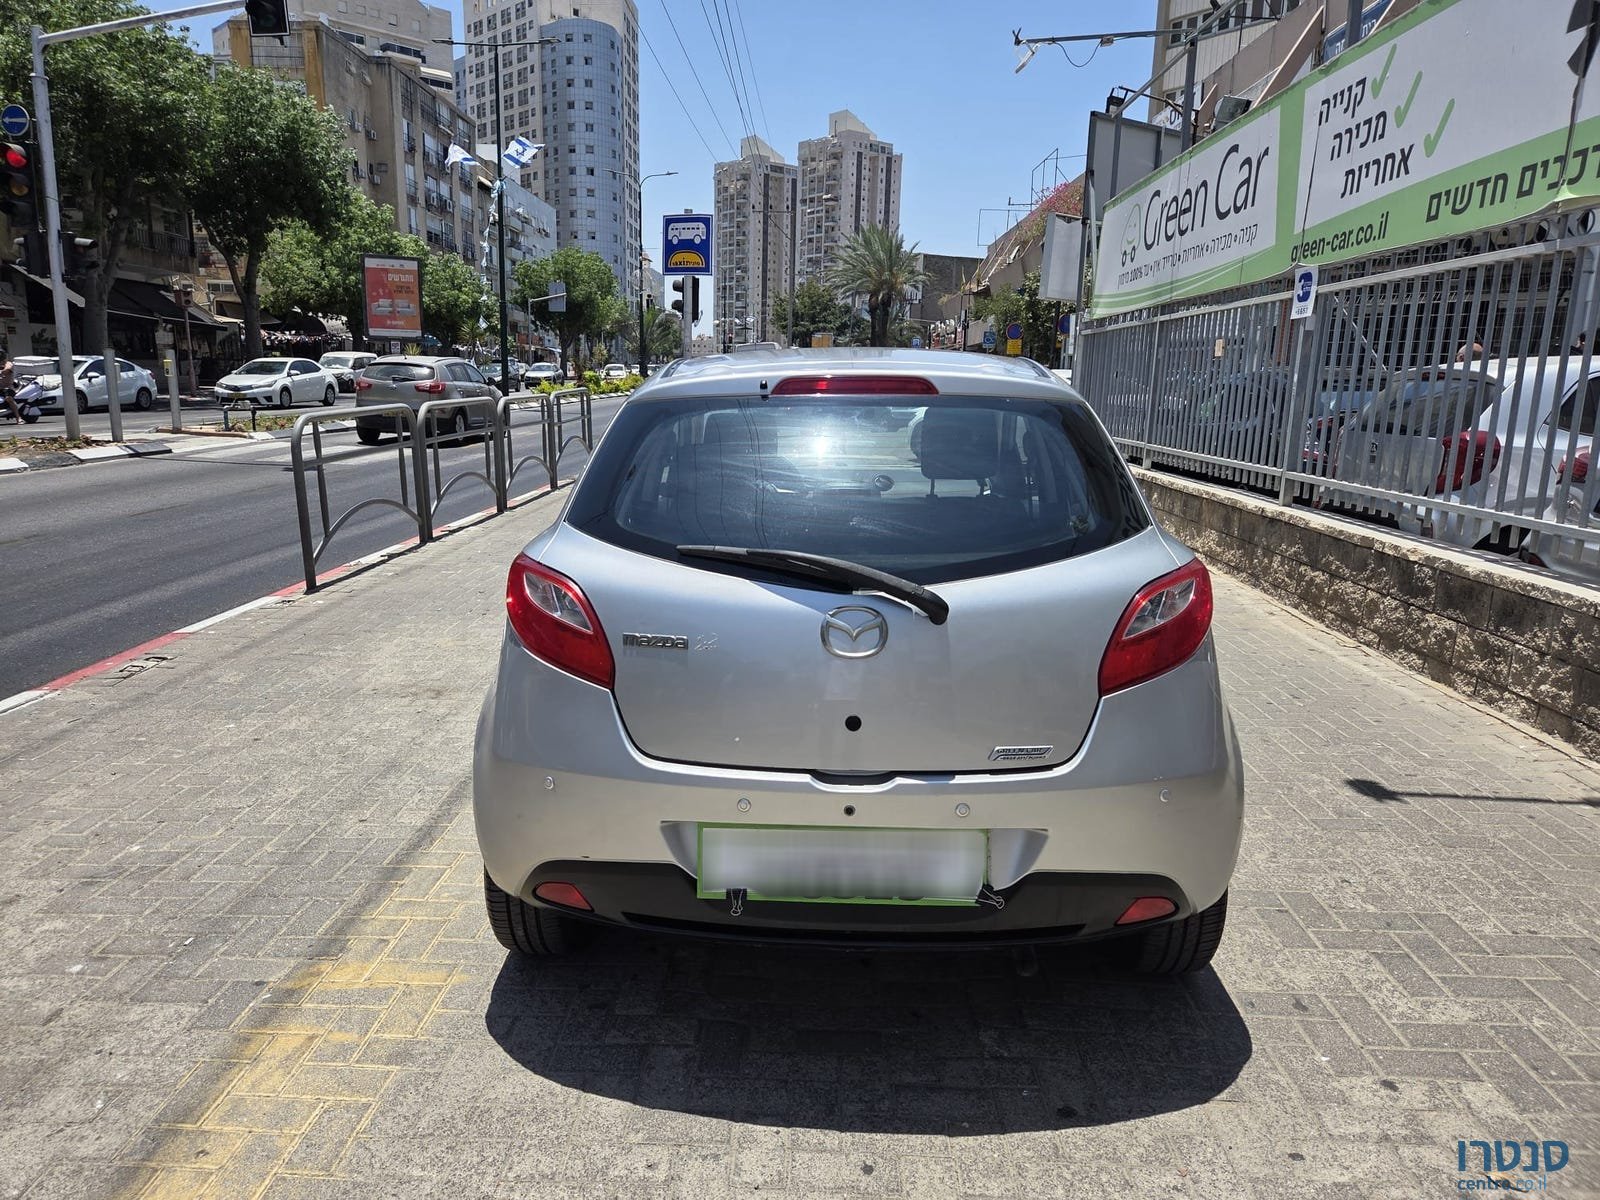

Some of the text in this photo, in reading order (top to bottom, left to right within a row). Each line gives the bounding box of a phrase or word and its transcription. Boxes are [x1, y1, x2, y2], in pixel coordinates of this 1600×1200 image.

[1318, 77, 1367, 127] קנייה
[1330, 110, 1387, 161] מכירה
[1144, 143, 1269, 250] Green Car
[1340, 143, 1415, 199] אחריות
[1426, 172, 1509, 223] חדשים
[1181, 242, 1206, 264] אחריות
[1210, 233, 1232, 254] מכירה
[1290, 211, 1389, 265] green-car.co.il
